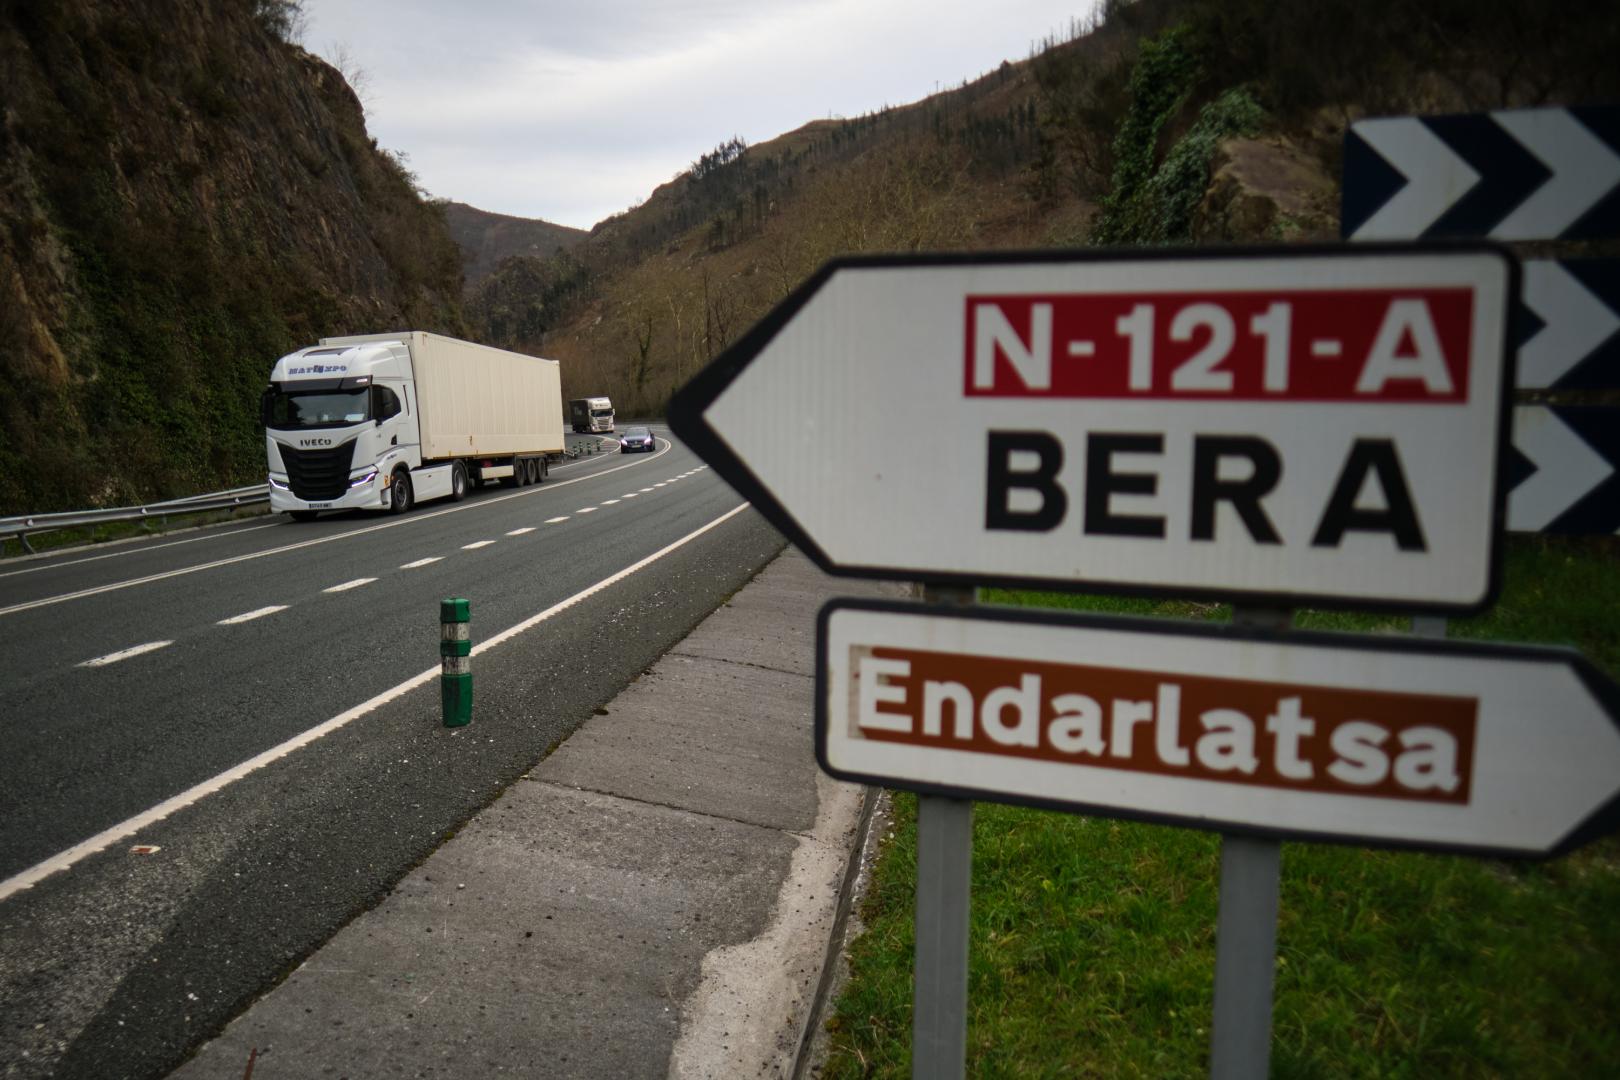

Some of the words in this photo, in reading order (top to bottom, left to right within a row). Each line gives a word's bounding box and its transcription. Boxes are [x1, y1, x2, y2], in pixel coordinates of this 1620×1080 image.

[973, 299, 1455, 394] N-121-A
[300, 438, 332, 447] IVECO
[984, 428, 1428, 553] BERA
[857, 656, 1461, 793] Endarlatsa
